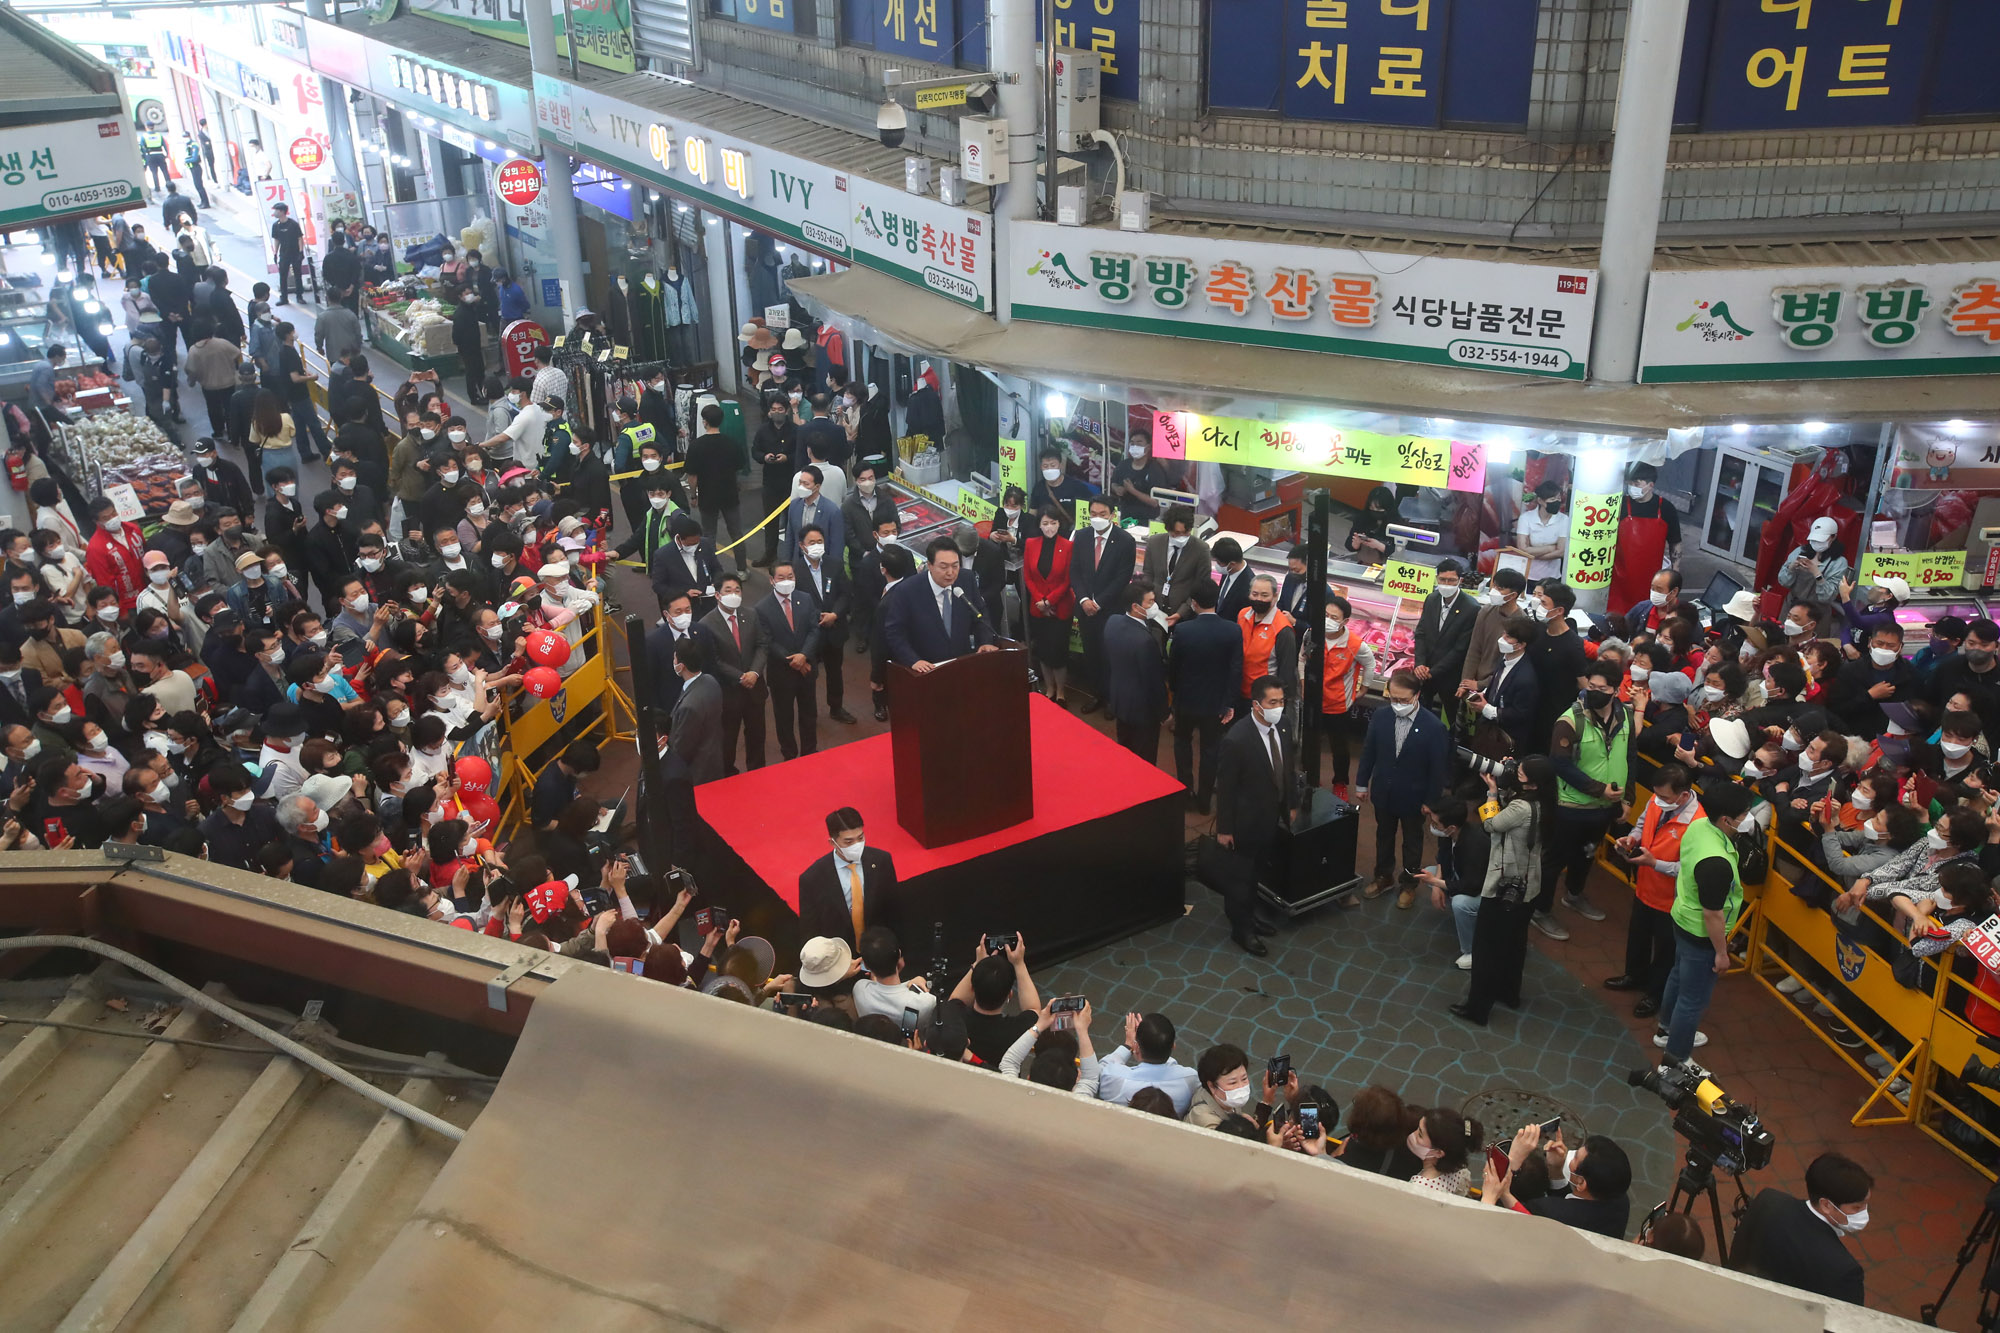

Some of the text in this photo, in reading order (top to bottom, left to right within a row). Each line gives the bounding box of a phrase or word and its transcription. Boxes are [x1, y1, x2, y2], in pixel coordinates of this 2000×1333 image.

[564, 22, 633, 62] 료체험센터
[1296, 41, 1427, 105] 치료
[1746, 44, 1891, 111] 어트
[934, 91, 949, 102] CCTV
[610, 113, 642, 148] IVY
[0, 147, 58, 185] 생선
[649, 123, 747, 199] 아이비
[48, 184, 127, 208] 010-4059-1398
[501, 177, 540, 195] 한의원
[770, 169, 814, 210] IVY
[805, 225, 843, 249] 032-552-4194
[928, 272, 974, 298] 032-554-1944
[1392, 296, 1566, 339] 식당납품전문
[1459, 345, 1559, 368] 032-554-1944
[1202, 425, 1239, 451] 다시
[1398, 441, 1446, 471] 일상으로
[1398, 566, 1415, 579] 한우
